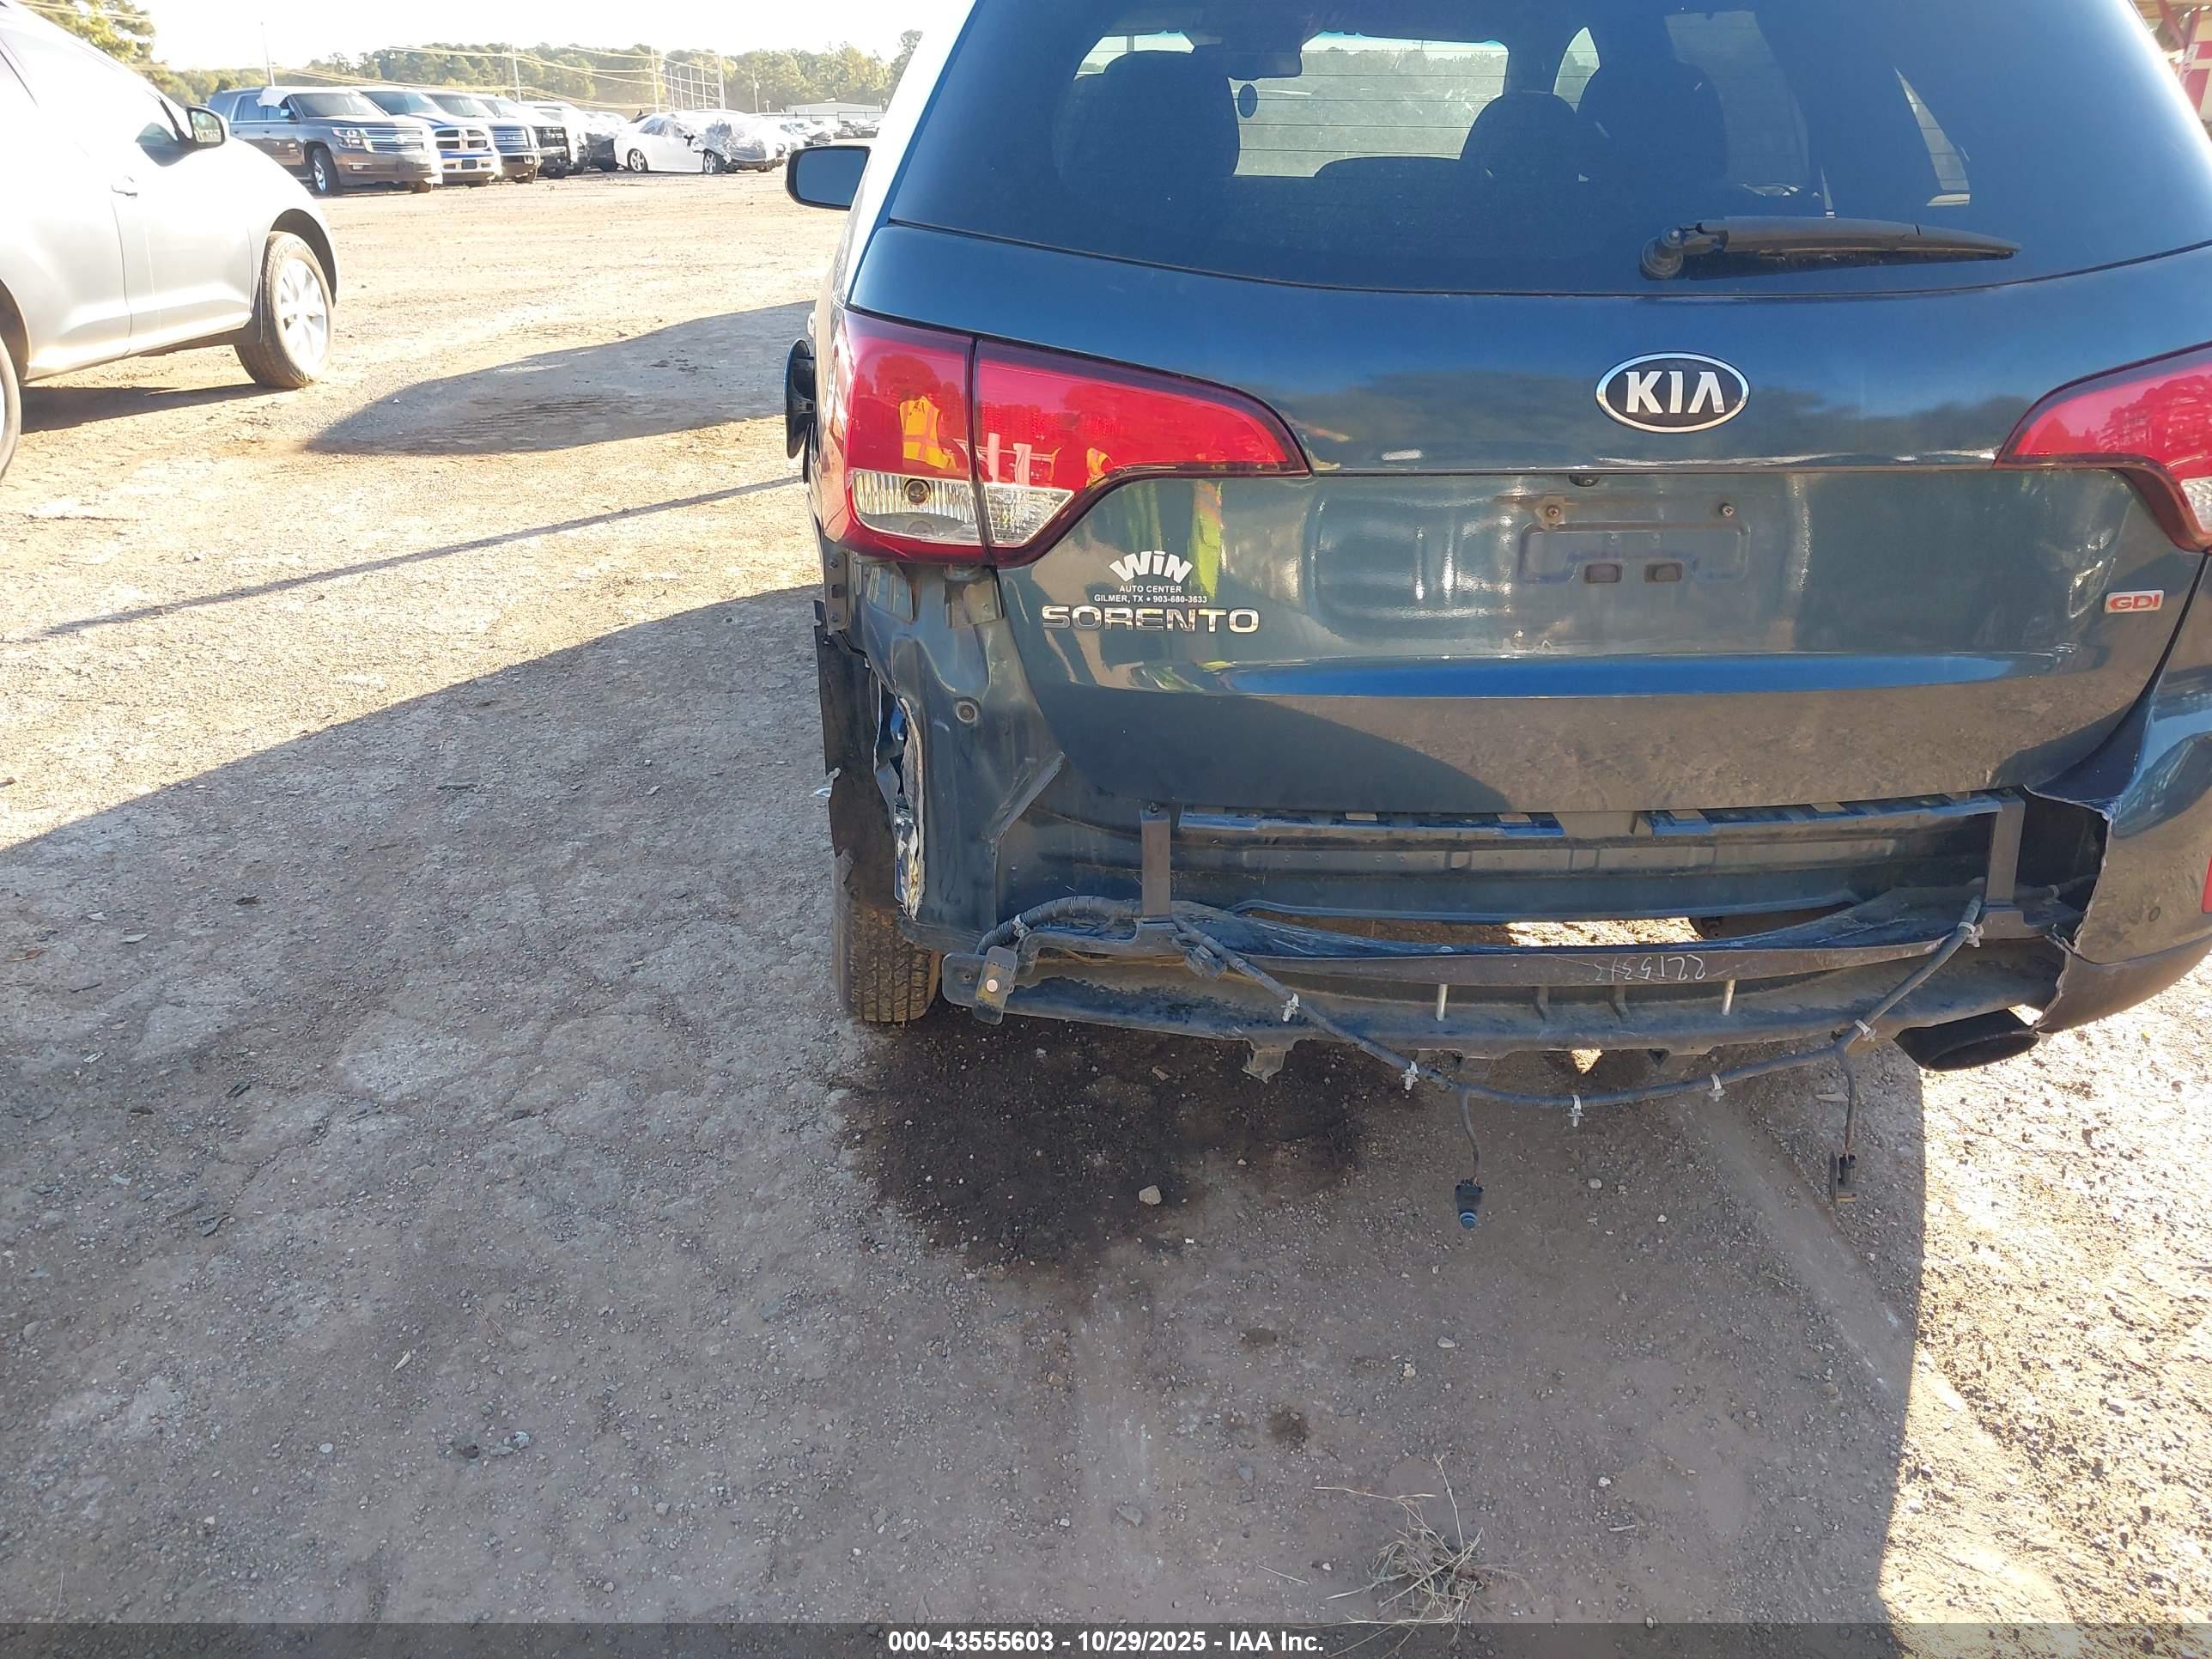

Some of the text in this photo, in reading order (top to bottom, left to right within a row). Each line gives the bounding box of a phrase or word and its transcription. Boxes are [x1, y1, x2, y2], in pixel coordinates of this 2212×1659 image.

[1626, 372, 1725, 414] KIA
[1094, 593, 1207, 604] GILMER, TX 903-680-3633
[2111, 594, 2160, 610] GDI
[1042, 605, 1260, 633] SORENTO
